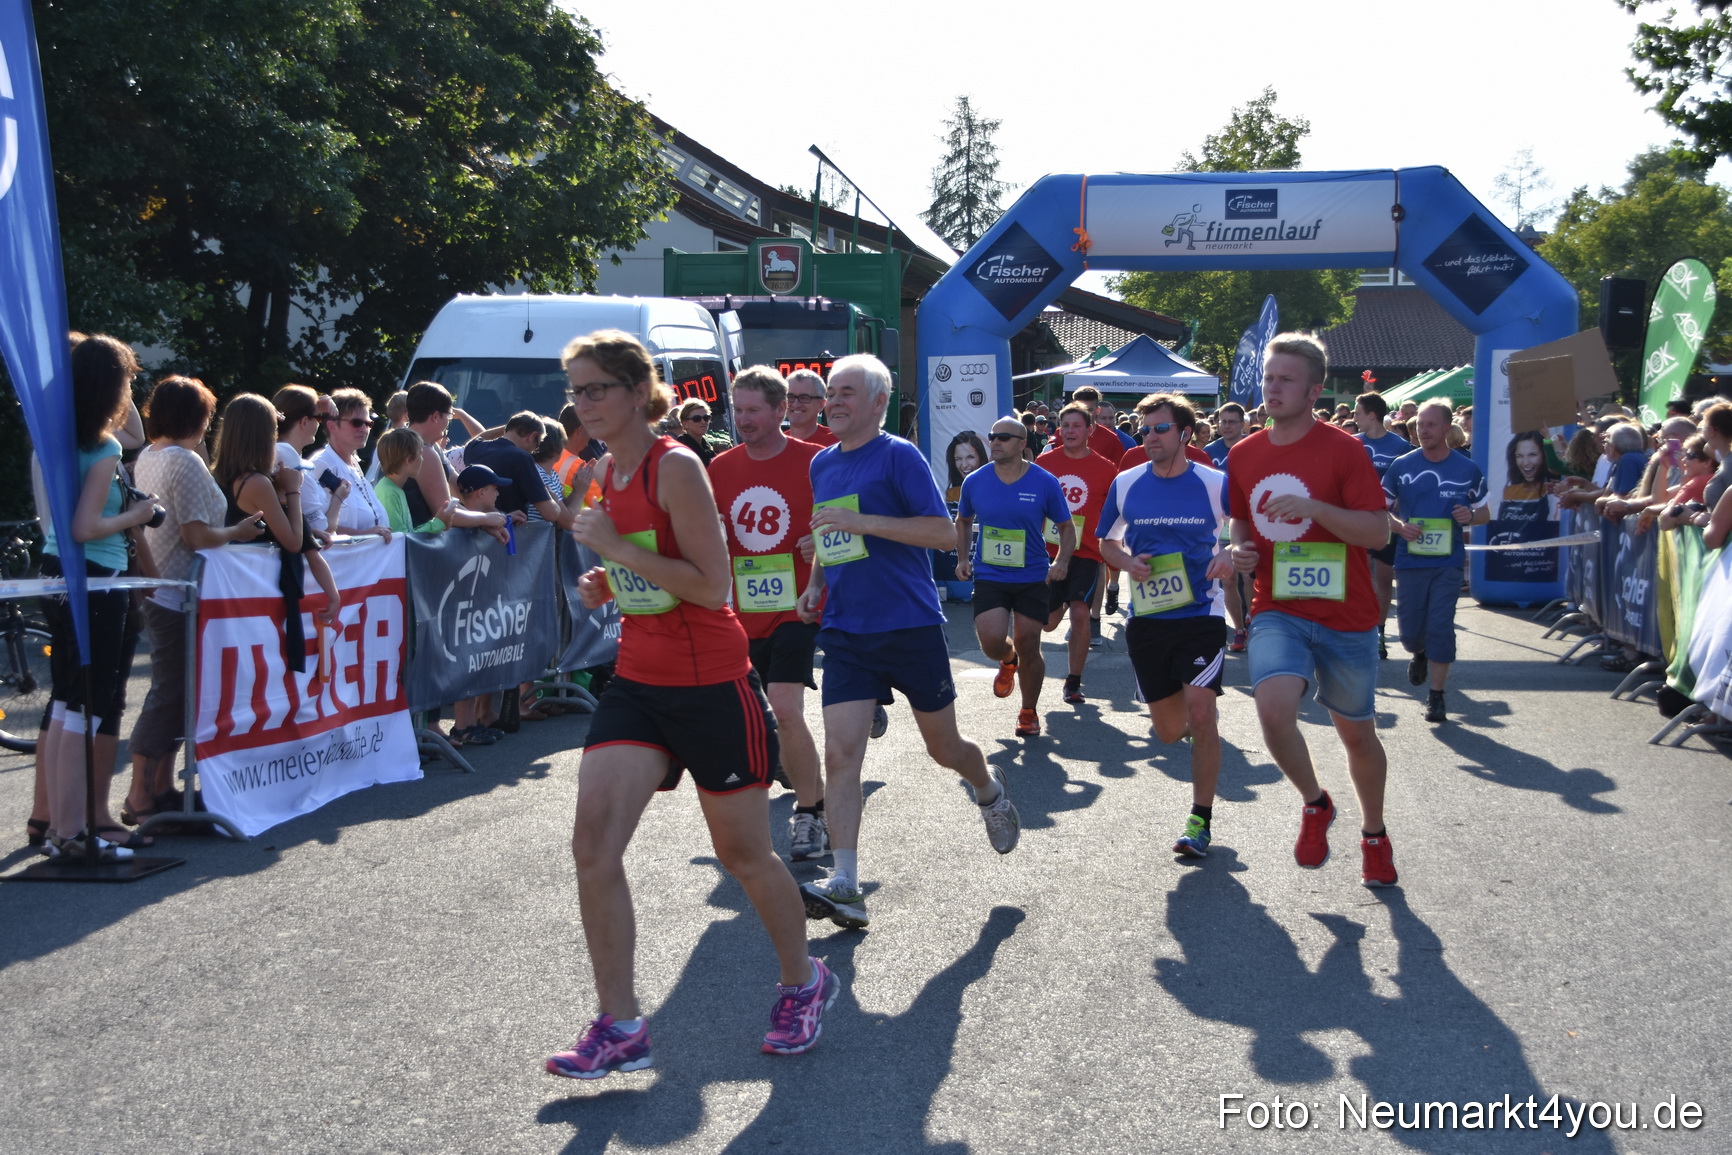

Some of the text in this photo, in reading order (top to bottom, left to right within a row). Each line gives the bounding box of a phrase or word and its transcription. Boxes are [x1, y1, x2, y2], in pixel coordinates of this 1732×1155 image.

[1236, 200, 1275, 209] Fischer
[1206, 219, 1322, 241] firmenlauf
[1205, 242, 1253, 250] neumarkt
[1444, 257, 1462, 267] und
[1464, 255, 1481, 264] das
[1493, 263, 1514, 271] mit!
[988, 265, 1049, 277] Fischer
[1672, 313, 1704, 352] AOK
[1644, 341, 1676, 385] AOK
[1093, 380, 1188, 389] www.fischer-automobile.de
[737, 501, 781, 536] 48
[1133, 516, 1205, 526] energiegeladen
[1416, 533, 1443, 545] 957
[994, 543, 1012, 556] 18
[1287, 567, 1330, 587] 550
[747, 577, 784, 597] 549
[1136, 575, 1183, 600] 1320
[454, 594, 533, 647] Fischer
[468, 643, 525, 673] AUTOMOBILE
